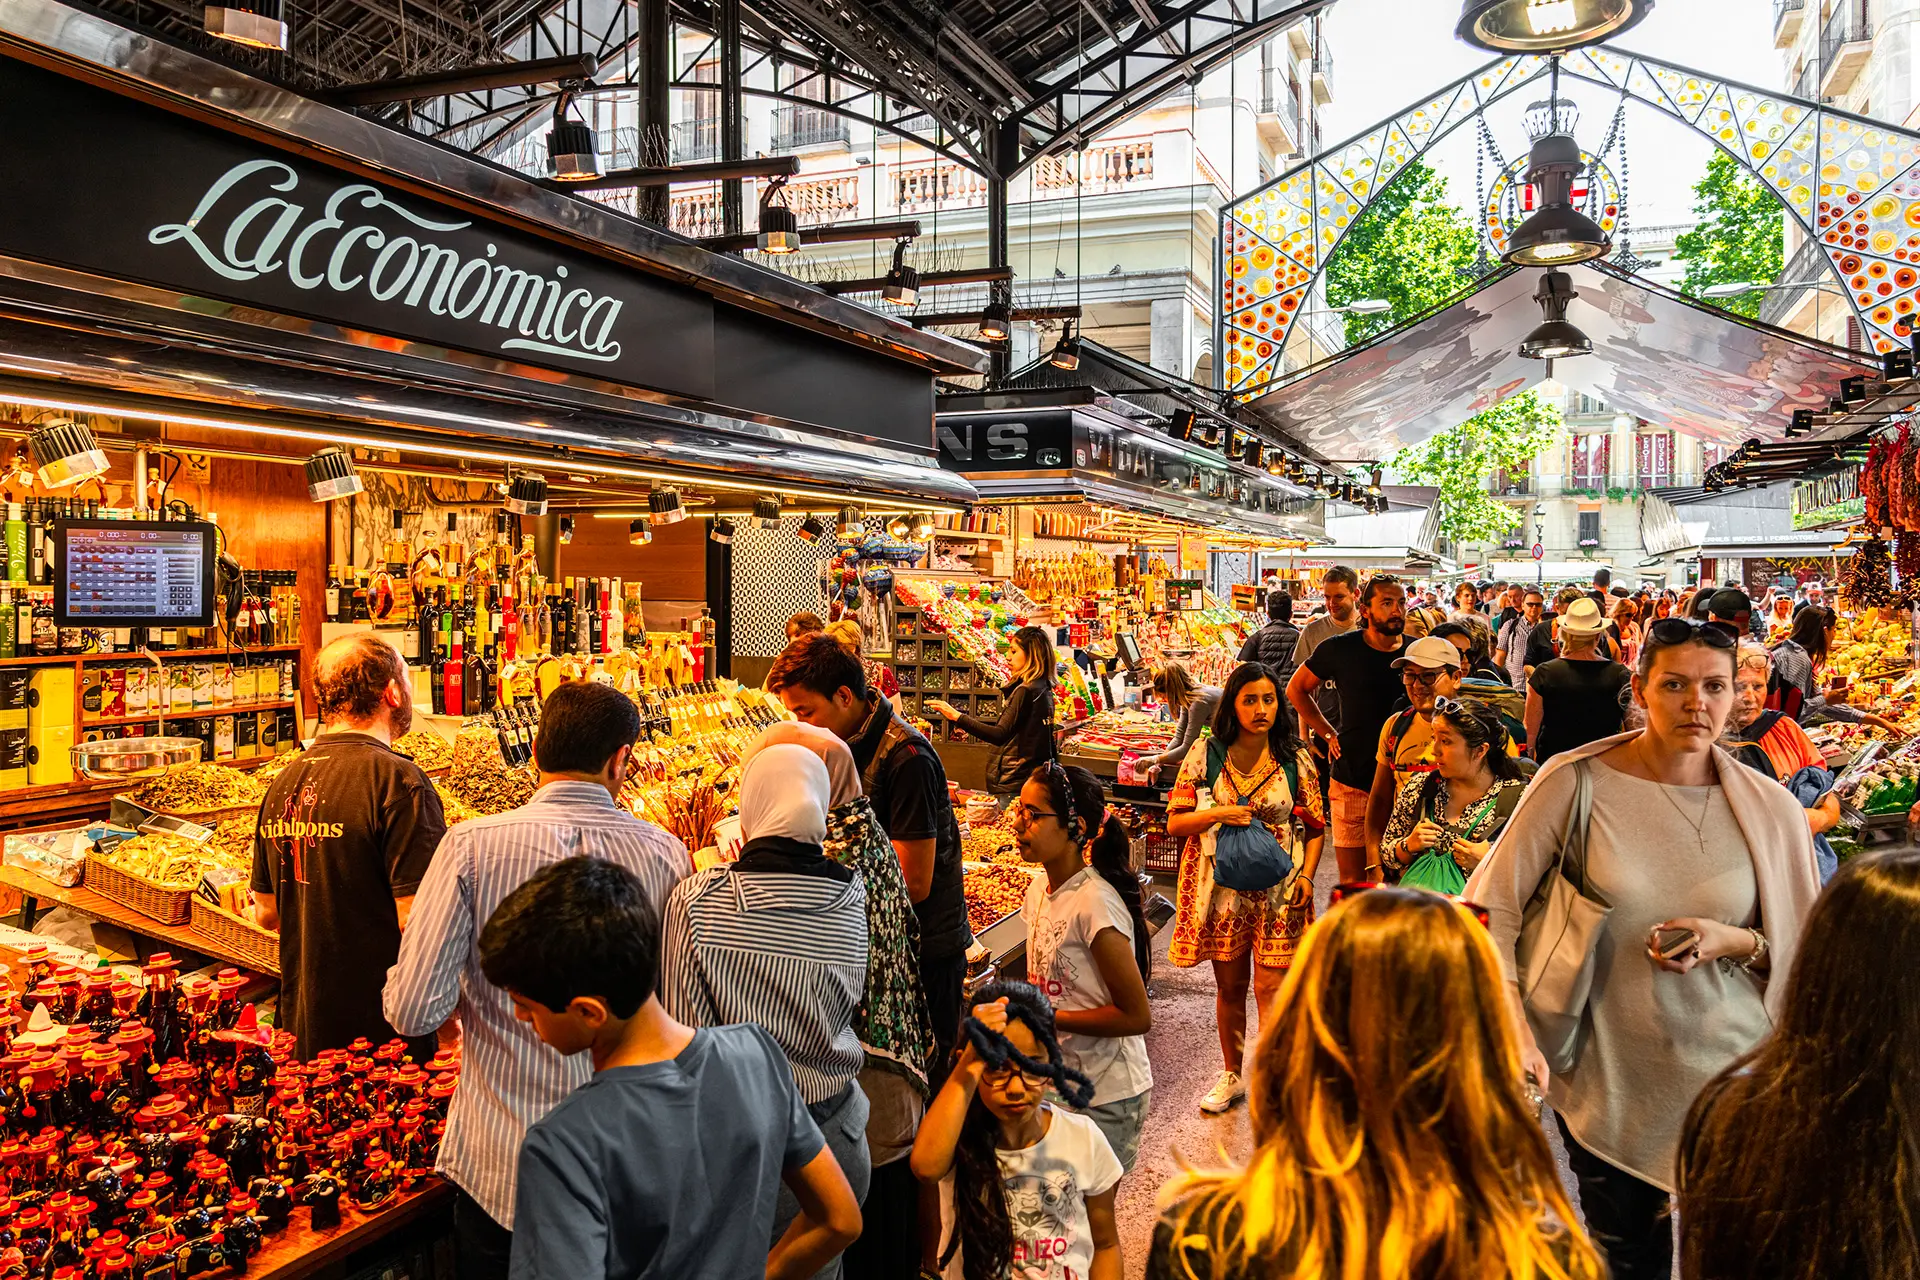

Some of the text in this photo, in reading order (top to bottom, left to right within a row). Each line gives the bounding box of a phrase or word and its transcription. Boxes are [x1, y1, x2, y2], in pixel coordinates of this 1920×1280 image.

[1642, 437, 1650, 474] EROTIC
[1657, 437, 1665, 474] MUSEUM
[1013, 1237, 1068, 1261] ENZO
